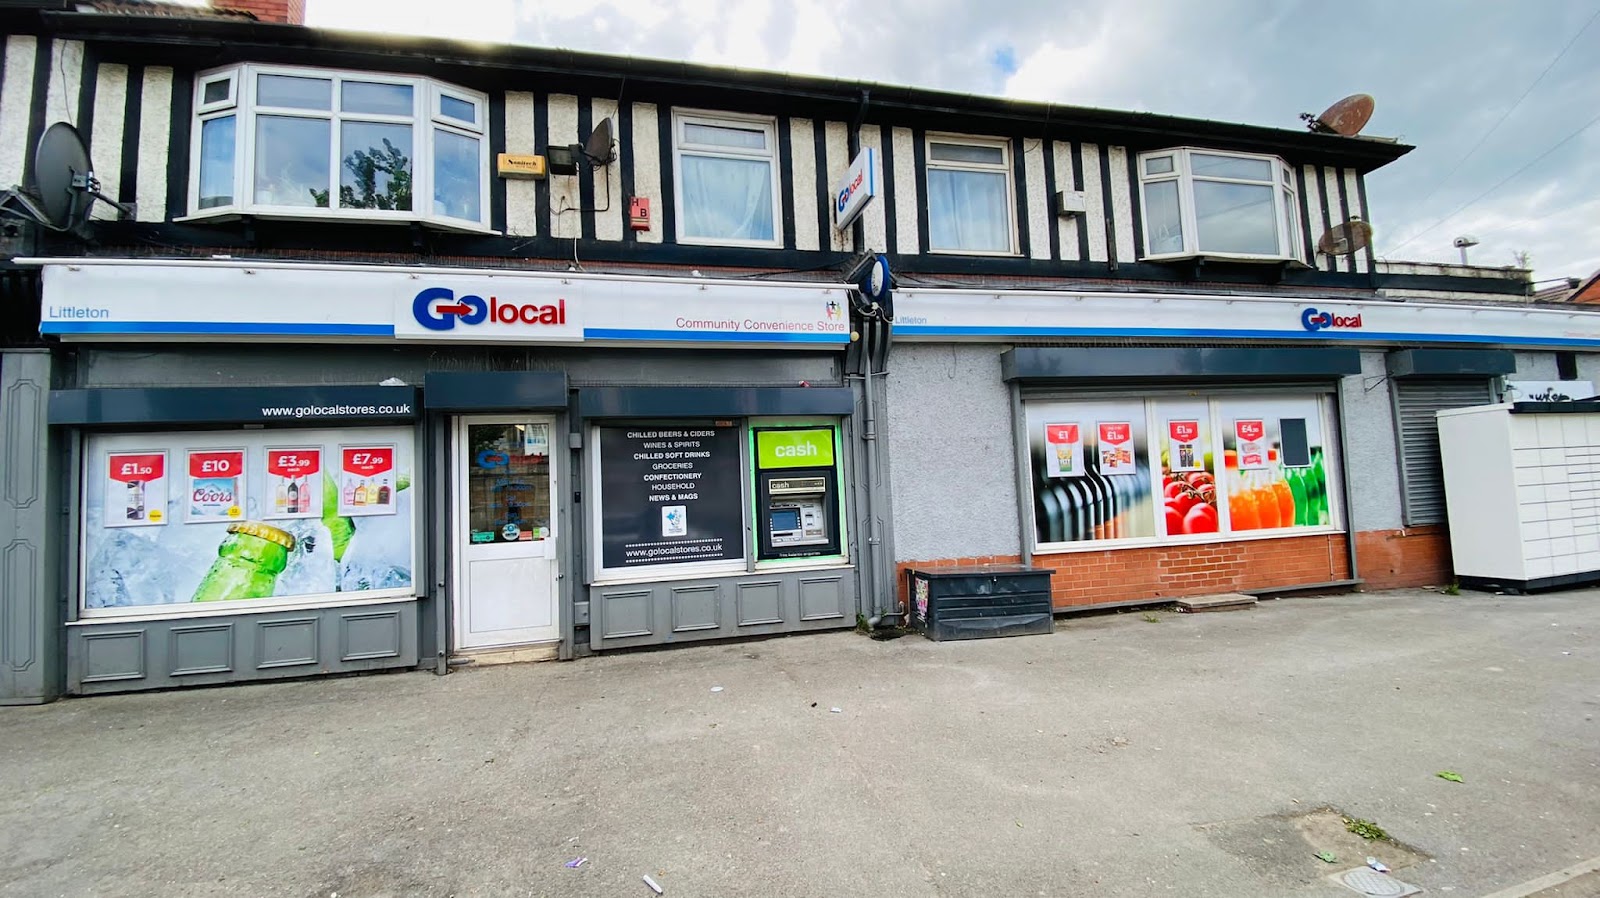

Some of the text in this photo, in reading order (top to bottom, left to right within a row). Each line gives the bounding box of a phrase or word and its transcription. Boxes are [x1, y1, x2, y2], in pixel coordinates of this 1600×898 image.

[640, 208, 647, 217] B
[49, 305, 109, 318] Littleton
[675, 317, 845, 331] Community Convenience Store
[895, 316, 927, 325] Littleton
[261, 403, 411, 418] www.golocalstores.co.uk
[775, 440, 817, 457] cash
[278, 455, 311, 467] £3.99
[352, 453, 384, 465] £7.99
[121, 463, 152, 475] £1.50
[202, 460, 230, 472] £10
[652, 462, 693, 470] GROCERIES
[643, 473, 702, 481] CONFECTIONERY
[651, 483, 695, 491] HOUSEHOLD
[772, 481, 790, 489] cash
[193, 488, 233, 502] Coors
[649, 494, 670, 502] NEWS
[625, 543, 723, 558] www.golocalstores.co.uk
